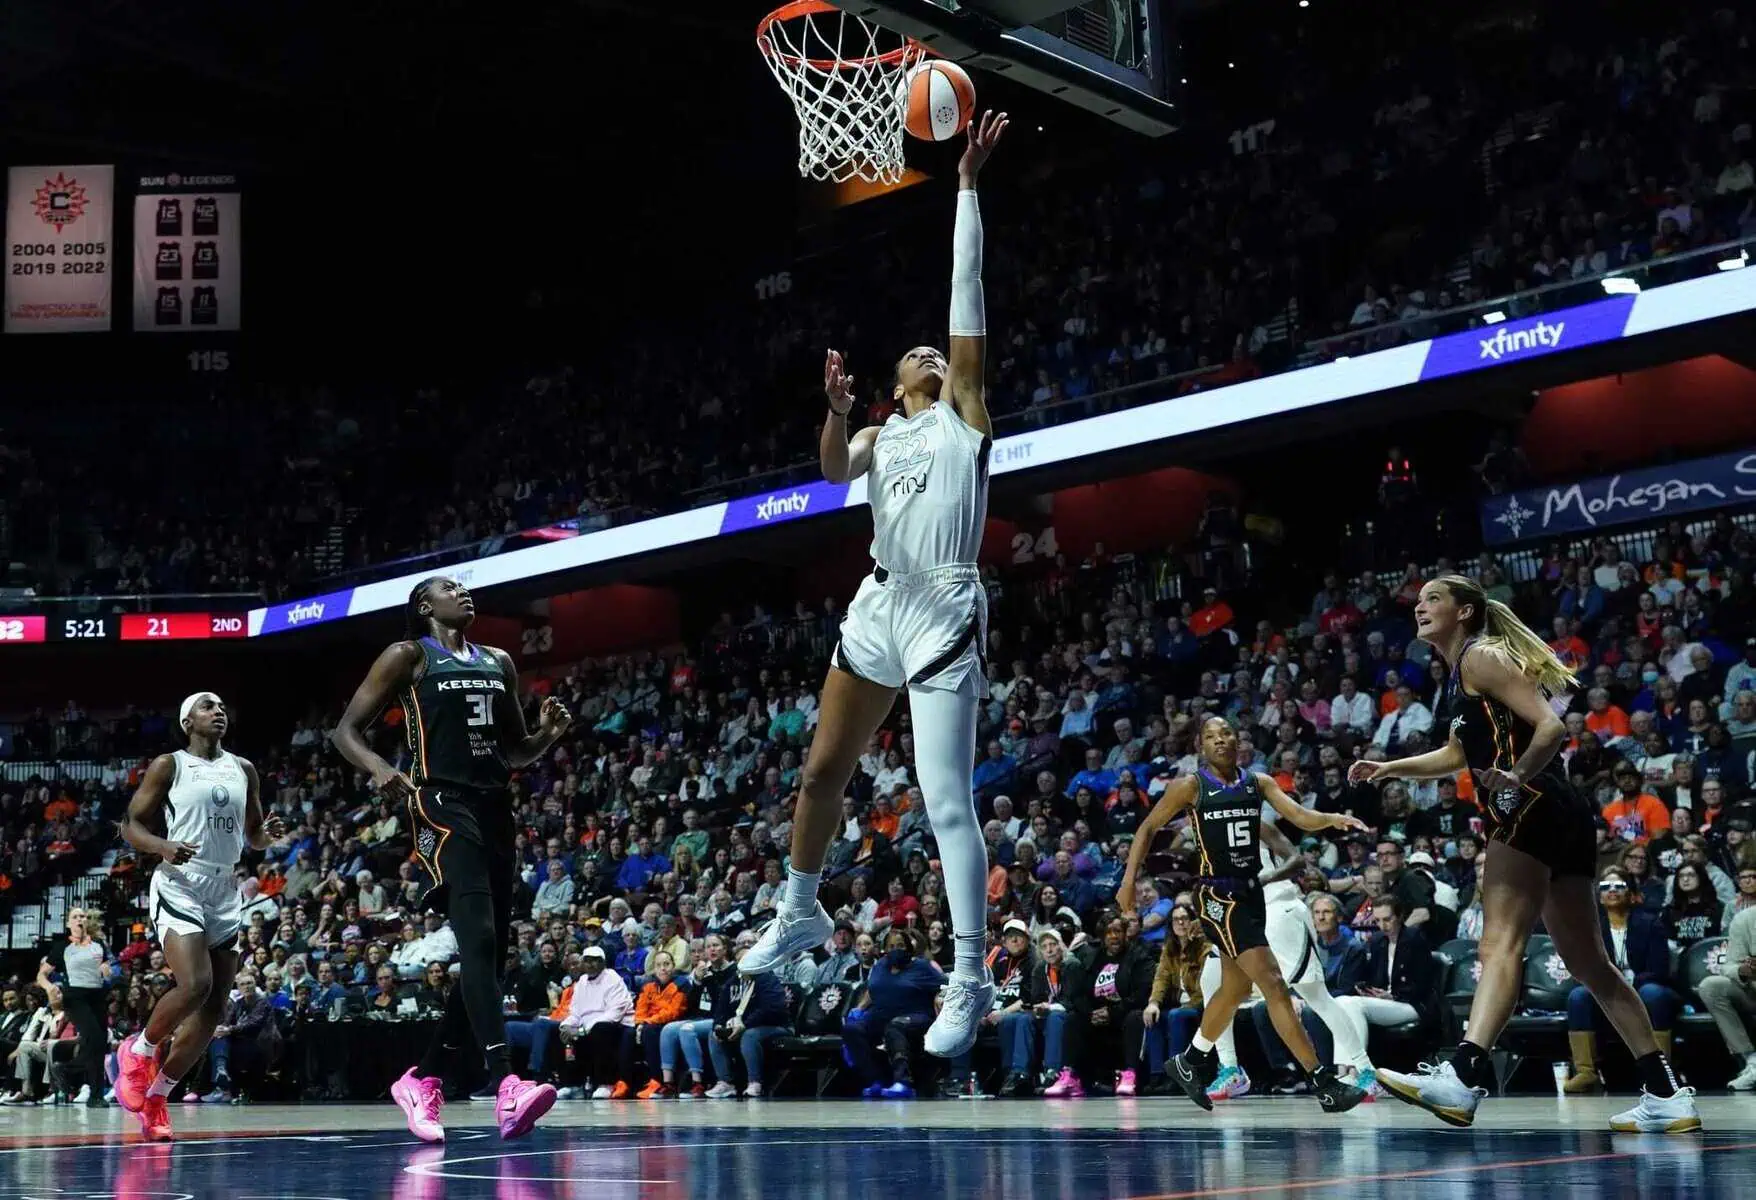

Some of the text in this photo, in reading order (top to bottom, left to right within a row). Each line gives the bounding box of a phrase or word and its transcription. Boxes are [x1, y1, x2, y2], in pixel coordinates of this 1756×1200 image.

[1228, 118, 1276, 156] 117
[140, 174, 236, 187] SUN LEGENDS
[161, 205, 177, 218] 12
[196, 204, 215, 217] 42
[12, 243, 105, 256] 2004 2005
[159, 249, 179, 262] 23
[12, 262, 105, 275] 2019 2022
[754, 271, 792, 300] 116
[161, 295, 176, 308] 15
[1479, 321, 1565, 360] xfinity
[187, 350, 230, 372] 115
[884, 433, 931, 473] 22
[1007, 443, 1033, 460] HIT
[892, 473, 927, 498] ring
[756, 492, 810, 520] xfinity
[1542, 475, 1726, 528] Mohegan
[1012, 527, 1059, 564] 24
[287, 601, 325, 624] xfinity
[64, 619, 106, 638] 5:21
[147, 618, 170, 636] 21
[212, 619, 242, 633] 2ND
[522, 626, 553, 655] 23
[466, 694, 494, 726] 31
[207, 813, 234, 834] ring
[1226, 820, 1251, 848] 15
